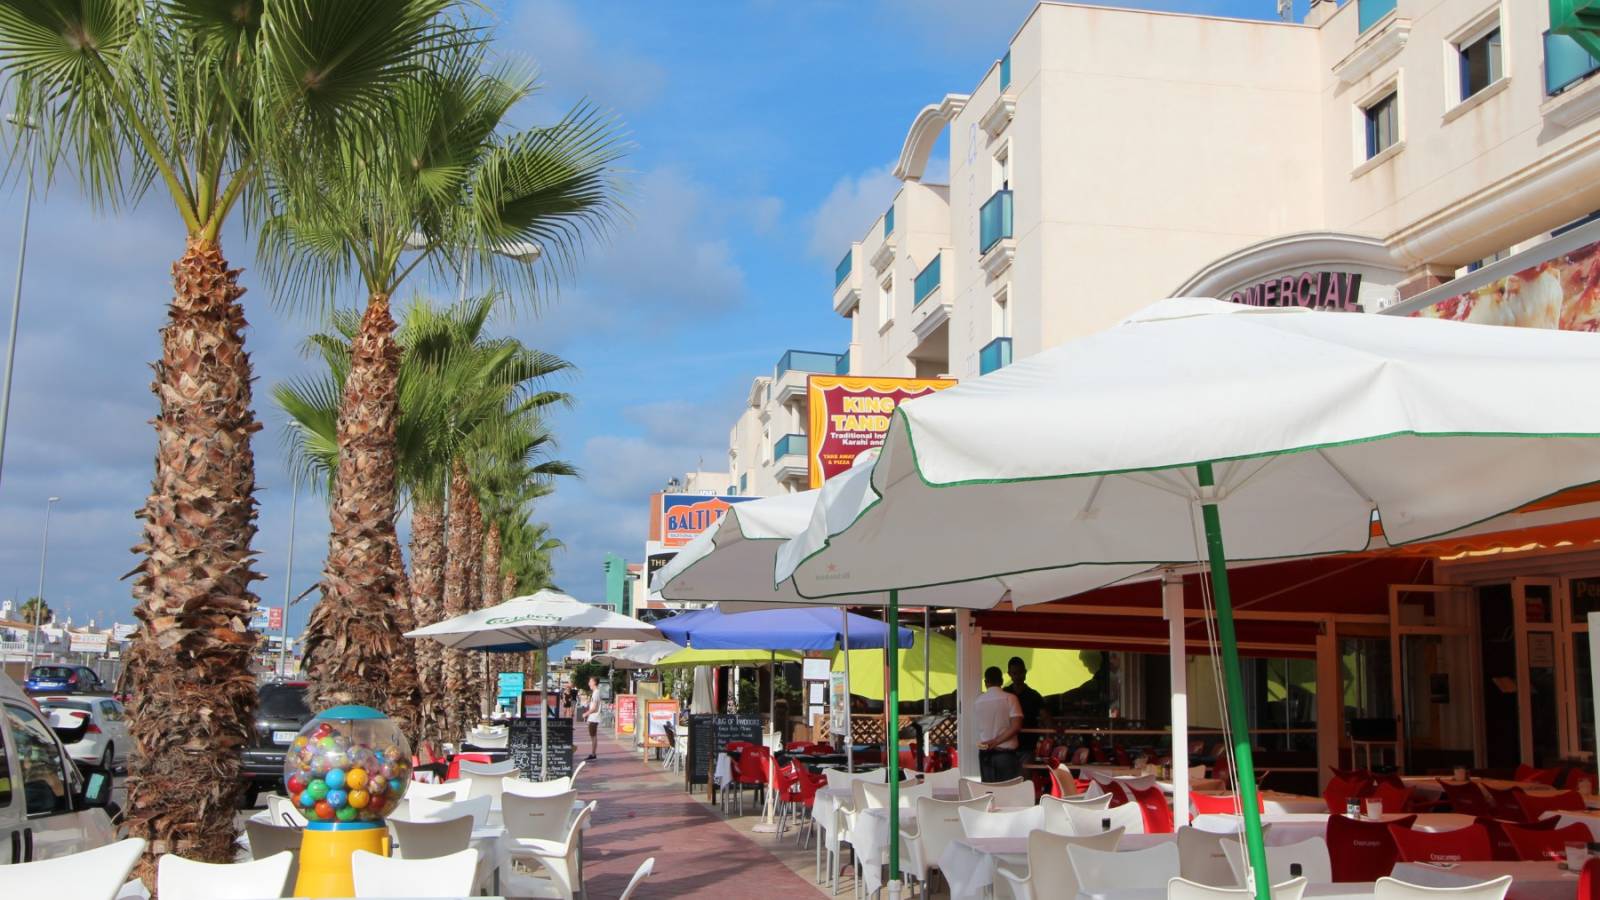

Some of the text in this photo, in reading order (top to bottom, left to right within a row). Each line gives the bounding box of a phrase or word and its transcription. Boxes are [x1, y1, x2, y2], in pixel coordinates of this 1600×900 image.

[842, 396, 895, 413] KING
[668, 509, 710, 530] BALTI
[651, 559, 666, 567] THE
